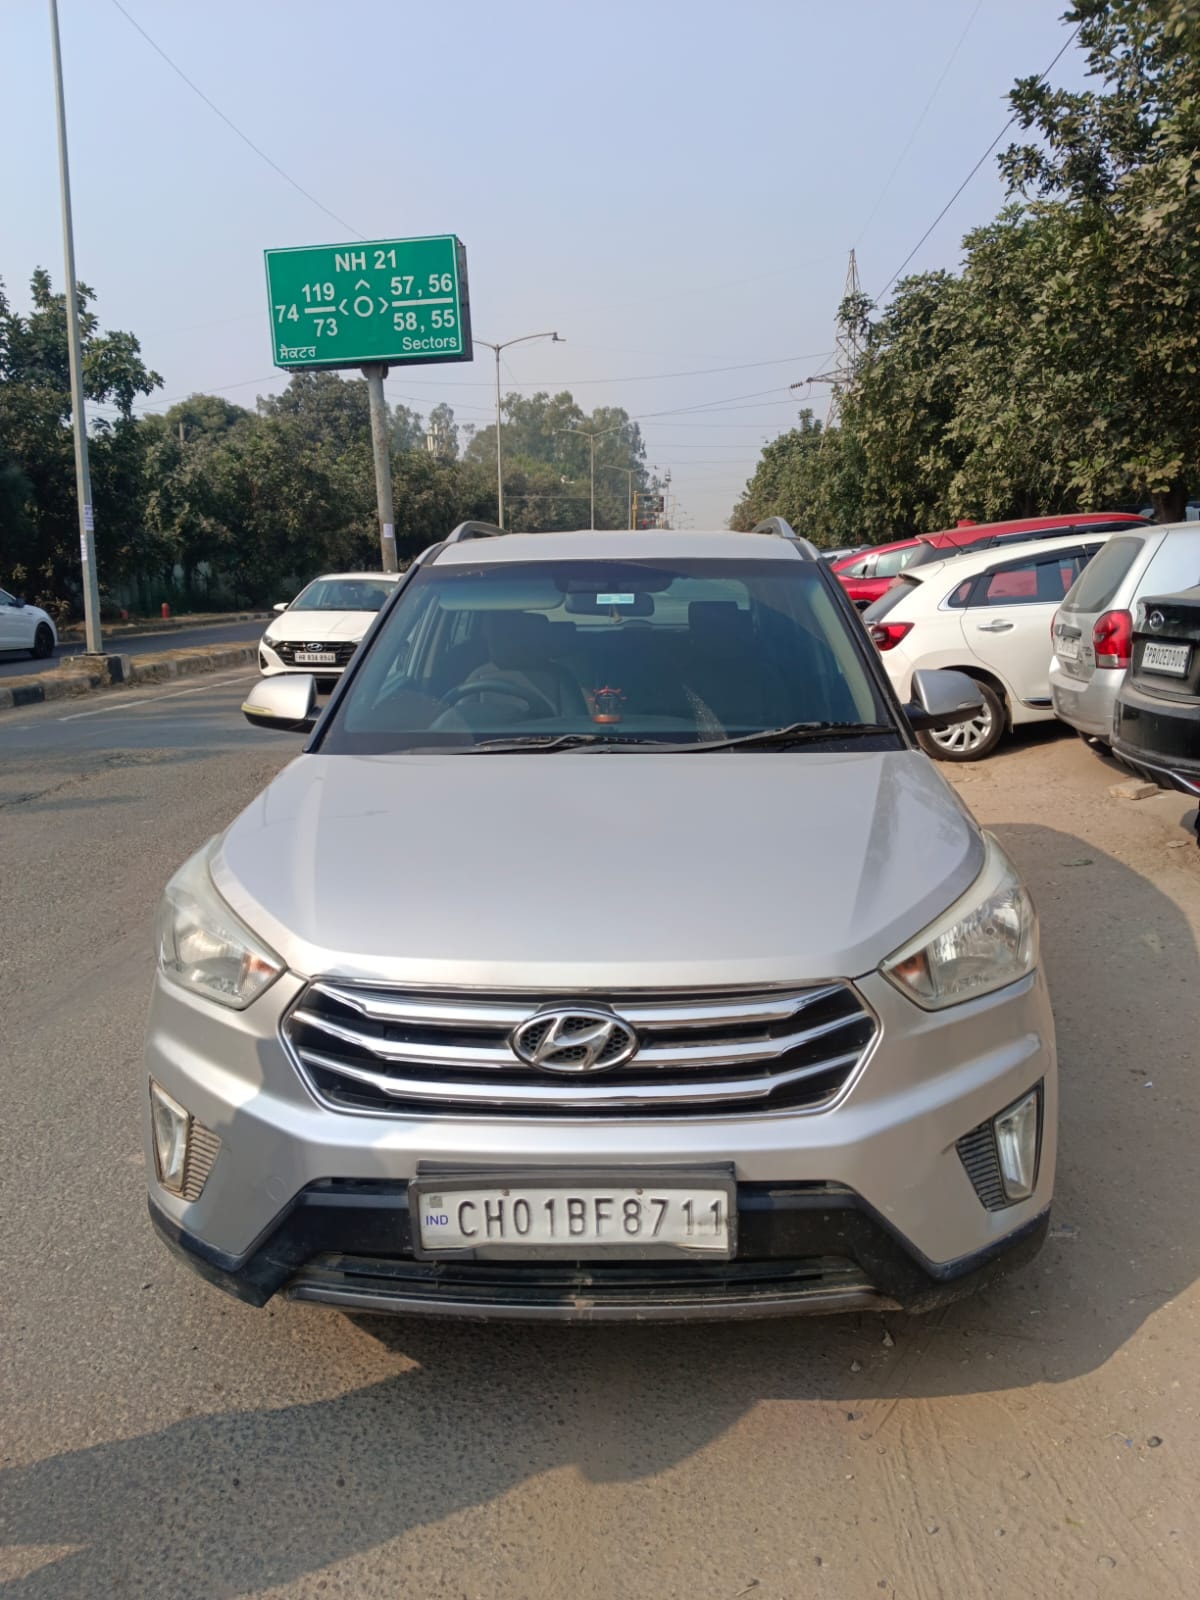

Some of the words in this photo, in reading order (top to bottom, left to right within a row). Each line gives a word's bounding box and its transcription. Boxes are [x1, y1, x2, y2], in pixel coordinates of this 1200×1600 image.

[335, 252, 367, 272] NH
[373, 250, 397, 270] 21
[302, 282, 335, 303] 119
[428, 273, 453, 293] 56
[275, 303, 299, 323] 74
[431, 309, 455, 329] 55
[313, 318, 338, 337] 73
[402, 336, 457, 350] Sectors
[425, 1215, 449, 1226] IND
